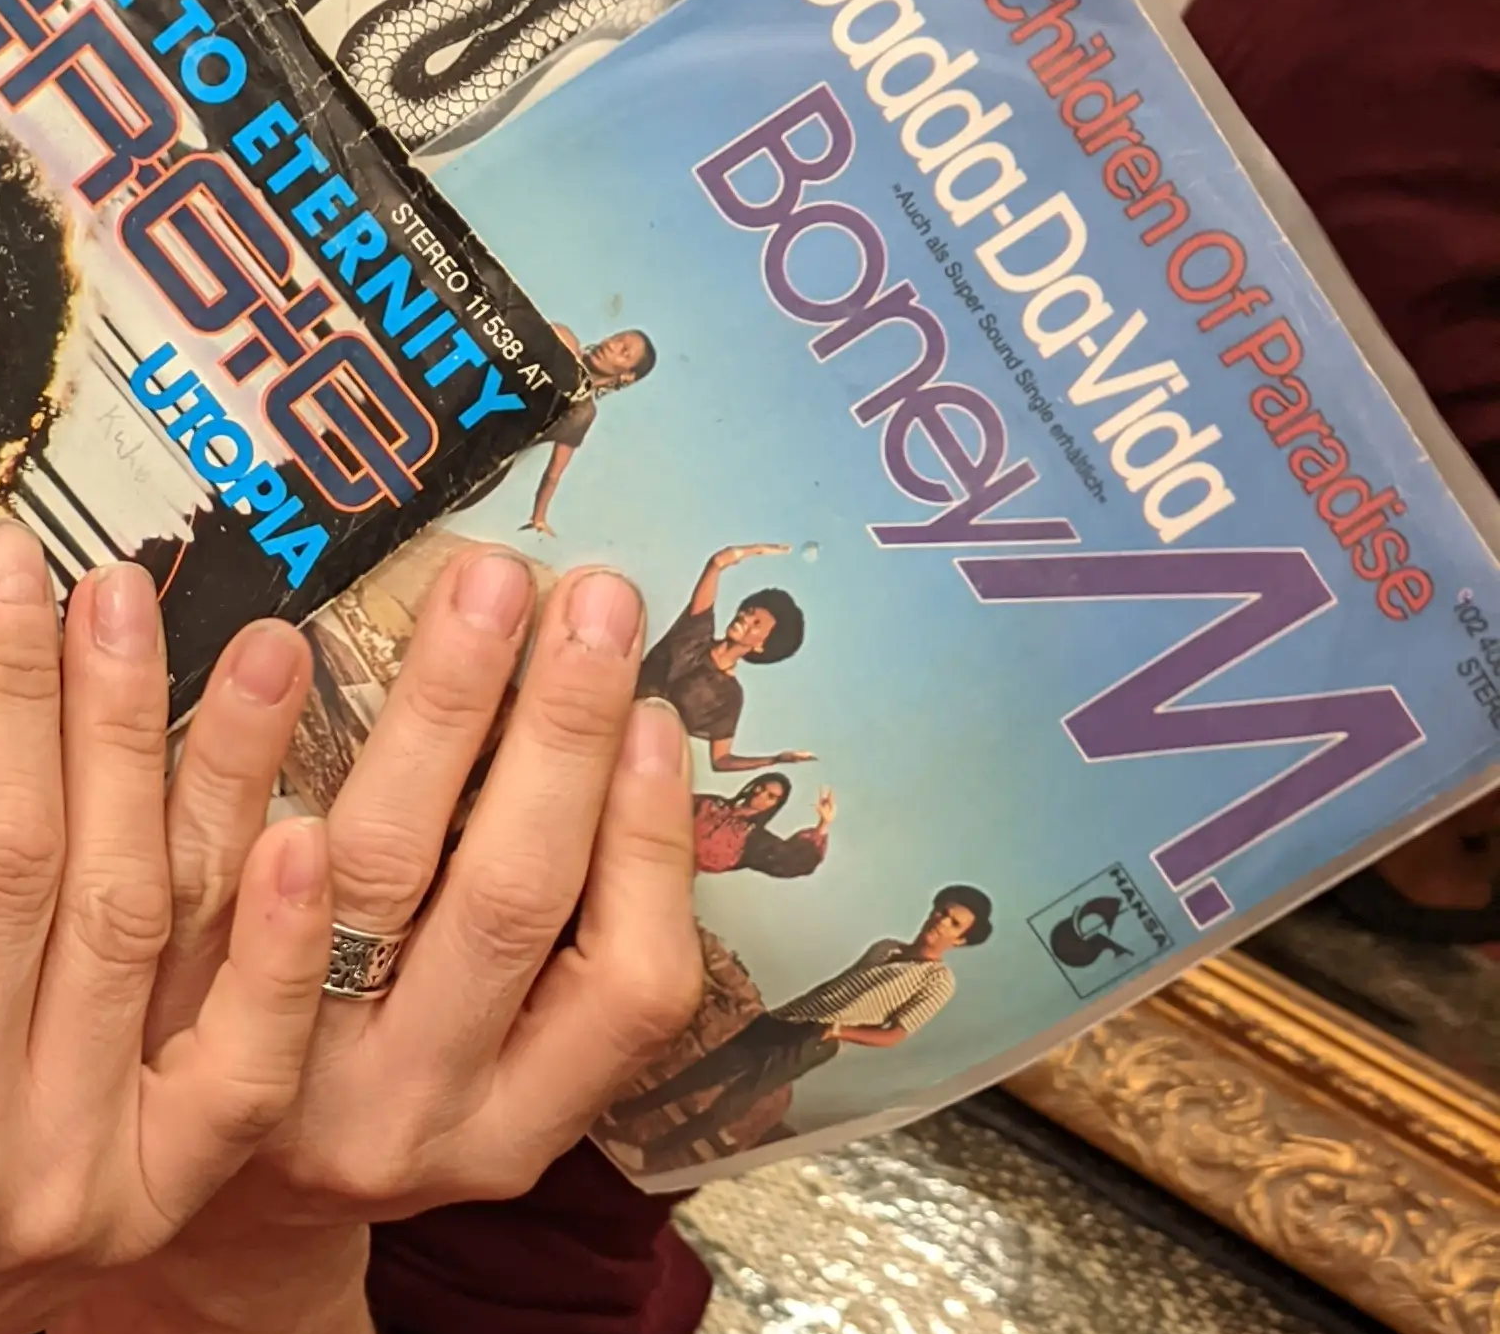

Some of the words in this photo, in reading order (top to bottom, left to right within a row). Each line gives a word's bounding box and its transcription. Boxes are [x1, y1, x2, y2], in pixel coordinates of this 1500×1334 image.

[232, 100, 527, 430] ETERNITY
[391, 202, 469, 294] STEREO
[691, 79, 1082, 550] Boney
[925, 236, 949, 264] als
[944, 260, 986, 315] Super
[978, 312, 1024, 371] Sound
[1014, 368, 1055, 424] Single
[1166, 228, 1273, 334] Of
[129, 341, 331, 590] UTOPIA
[1218, 316, 1434, 622] Paradise
[1108, 868, 1168, 950] HANSA
